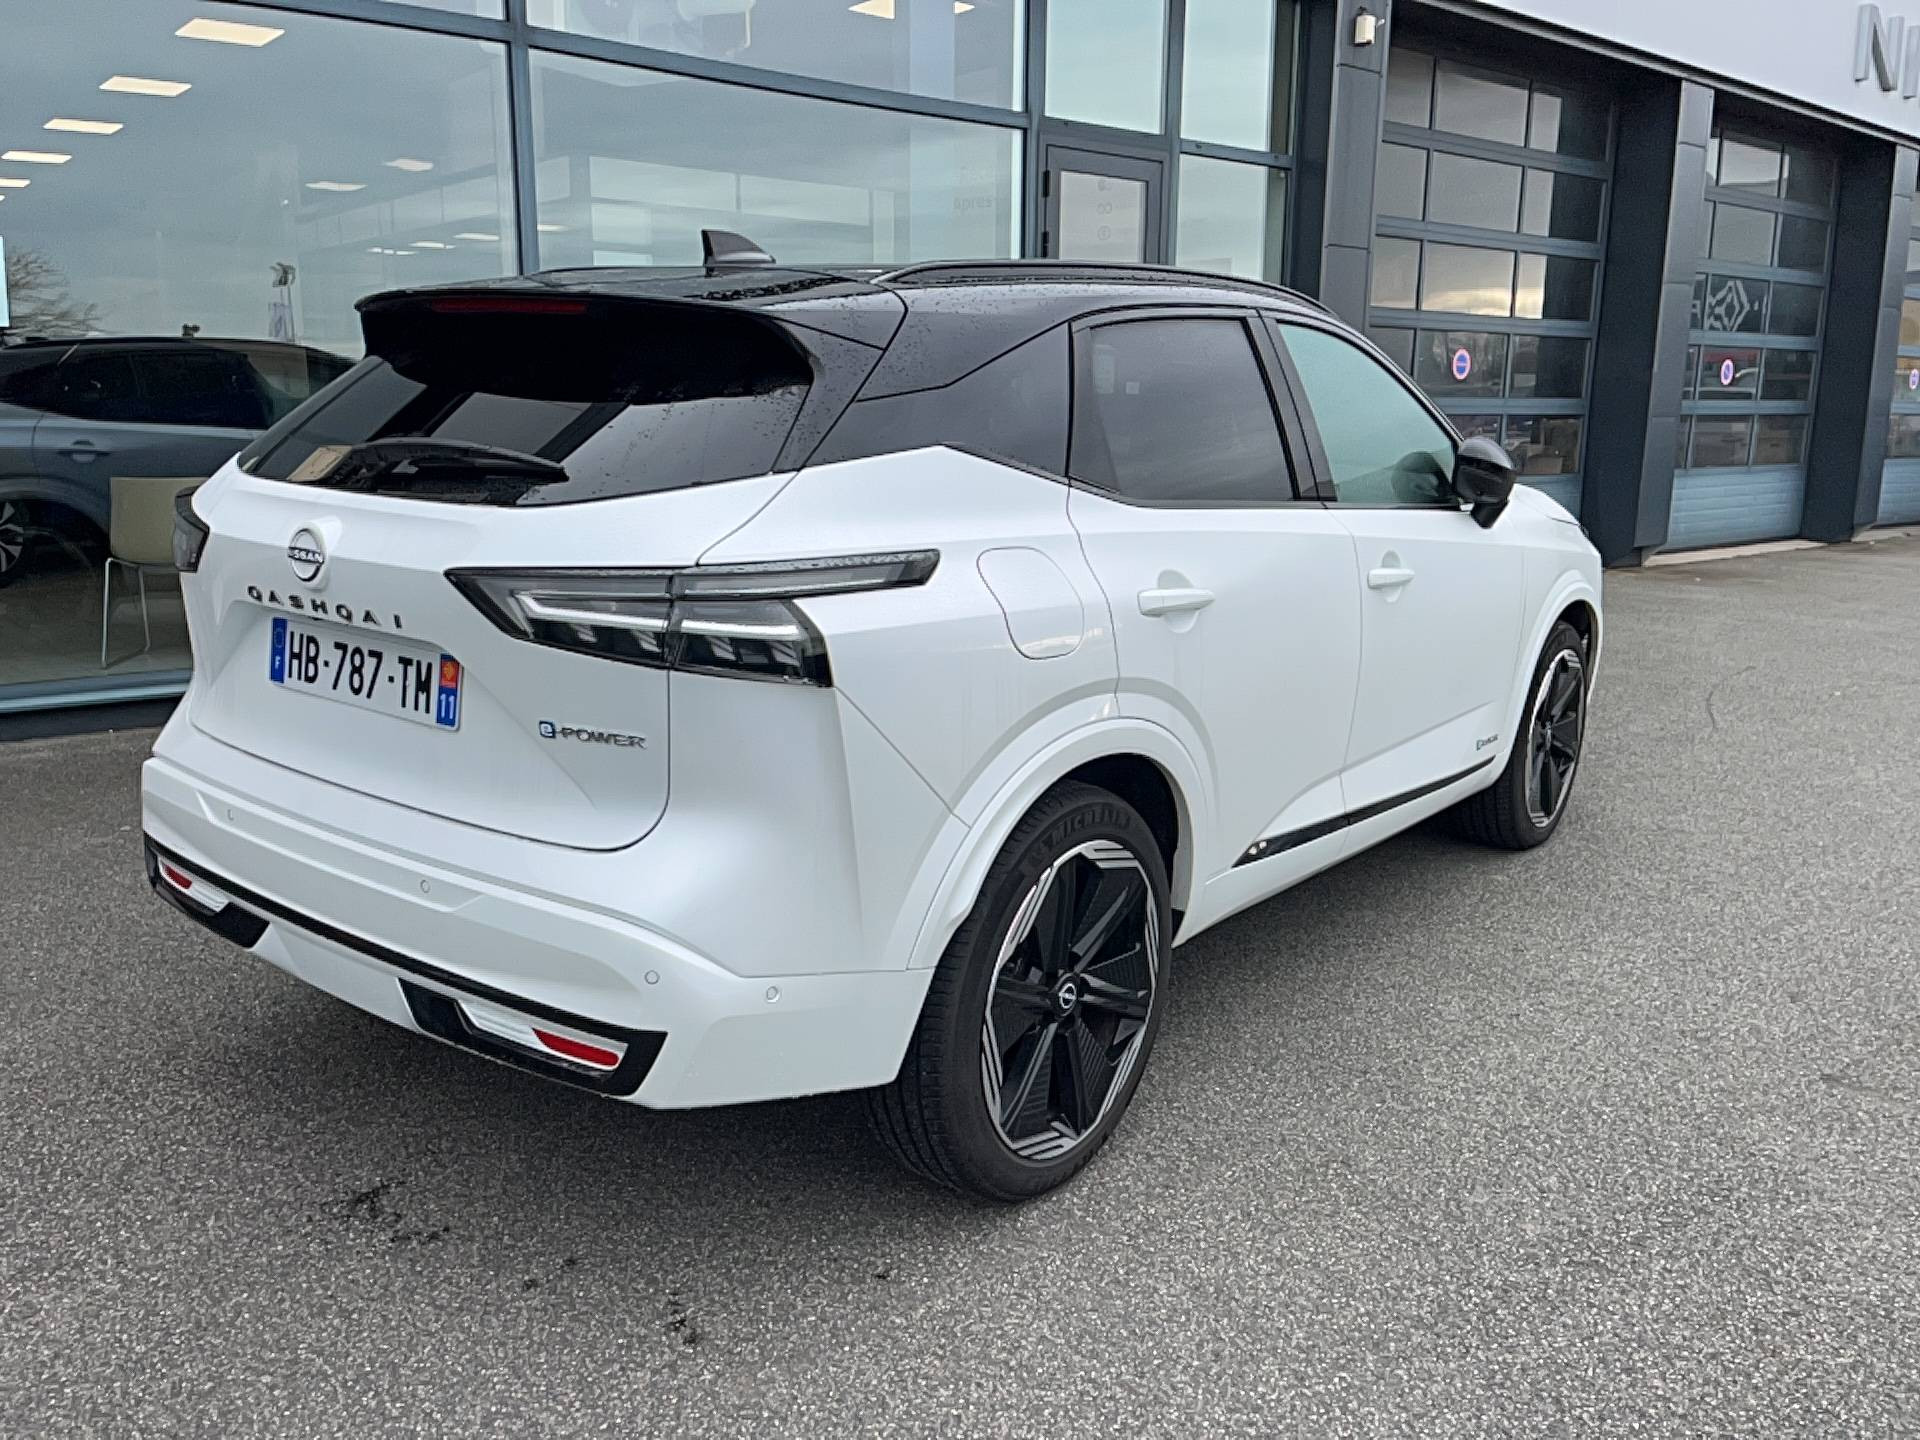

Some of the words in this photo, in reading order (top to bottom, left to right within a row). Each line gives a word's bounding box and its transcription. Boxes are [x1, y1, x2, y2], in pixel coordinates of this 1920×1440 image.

[289, 548, 323, 562] SSAN
[247, 586, 402, 628] QASHQAI
[274, 655, 281, 669] F
[288, 631, 432, 714] HB-787-TM
[440, 693, 456, 720] 11
